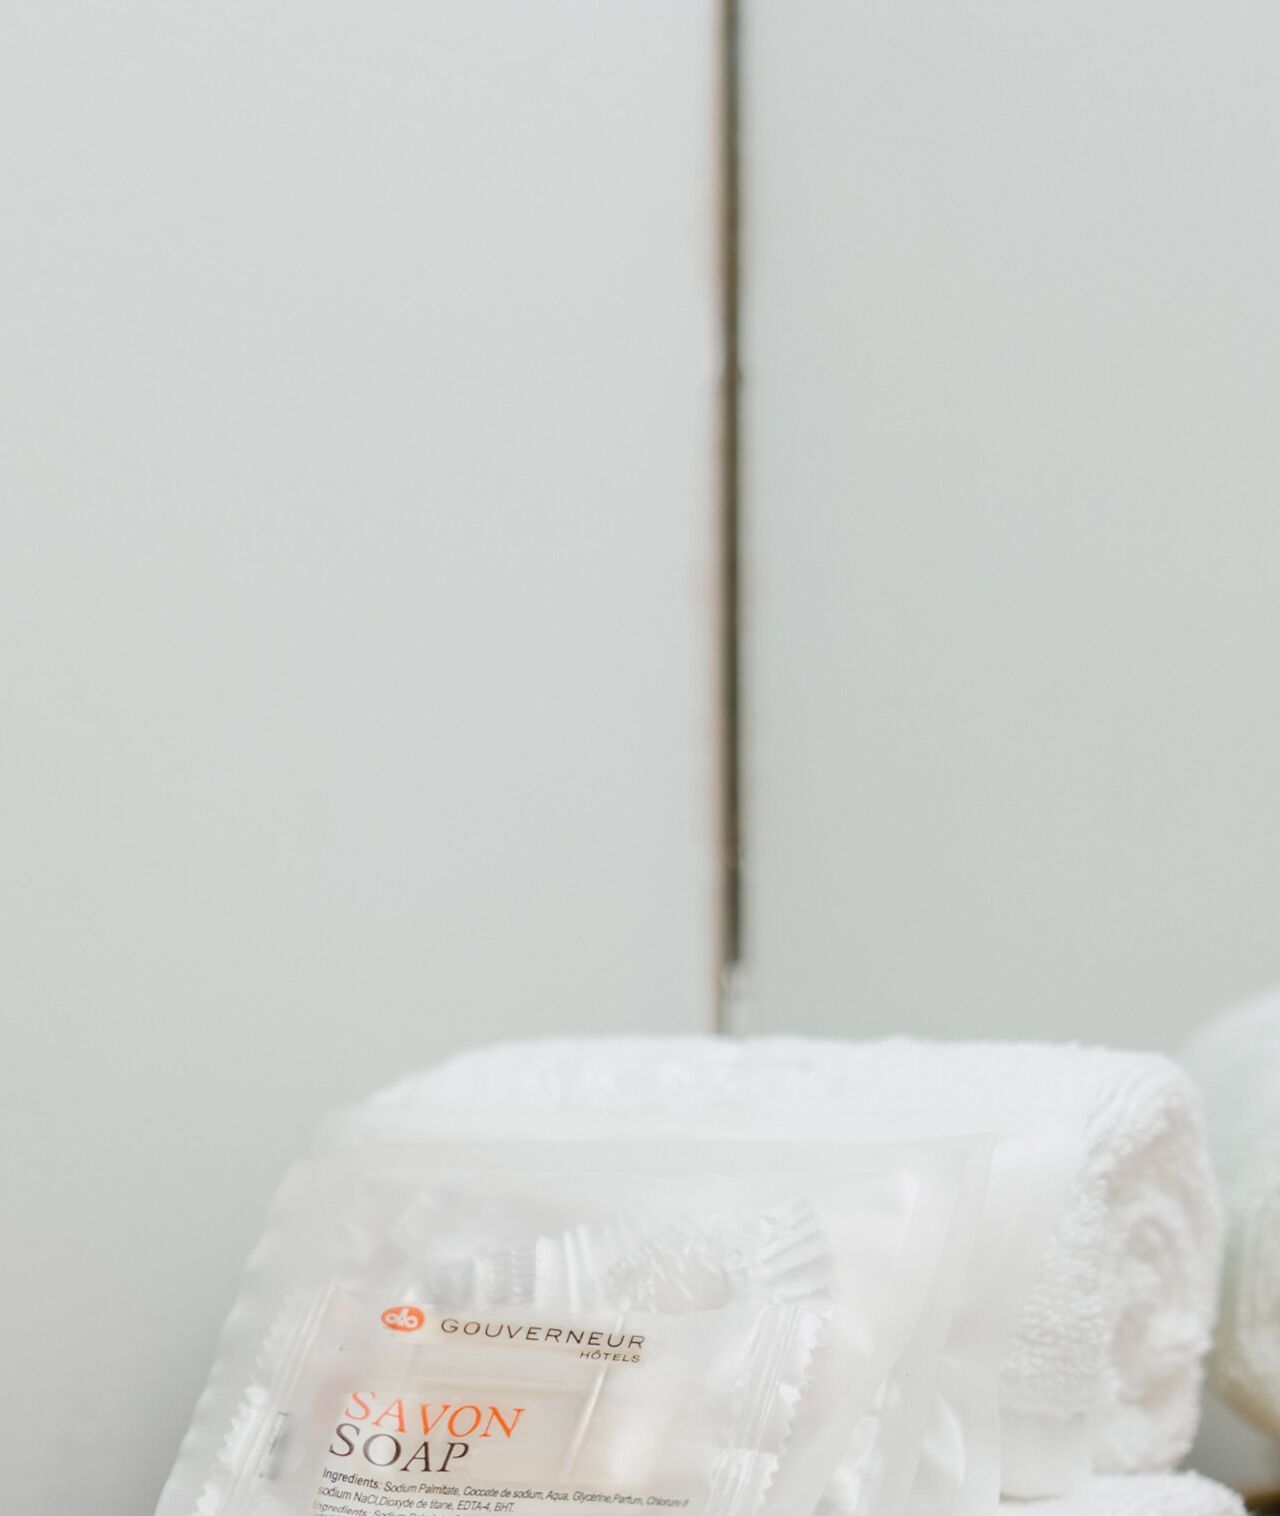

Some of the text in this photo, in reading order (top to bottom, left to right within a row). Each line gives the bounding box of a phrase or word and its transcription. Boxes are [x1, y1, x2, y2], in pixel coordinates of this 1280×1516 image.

[440, 1318, 646, 1349] GOUVERNEUR
[579, 1349, 640, 1363] HÔTELS
[344, 1391, 525, 1438] SAVON
[328, 1423, 470, 1473] SOAP
[317, 1486, 352, 1500] sodium
[416, 1499, 428, 1509] de
[322, 1467, 382, 1489] Ingredients:
[384, 1481, 418, 1494] Sodium
[500, 1488, 512, 1498] de
